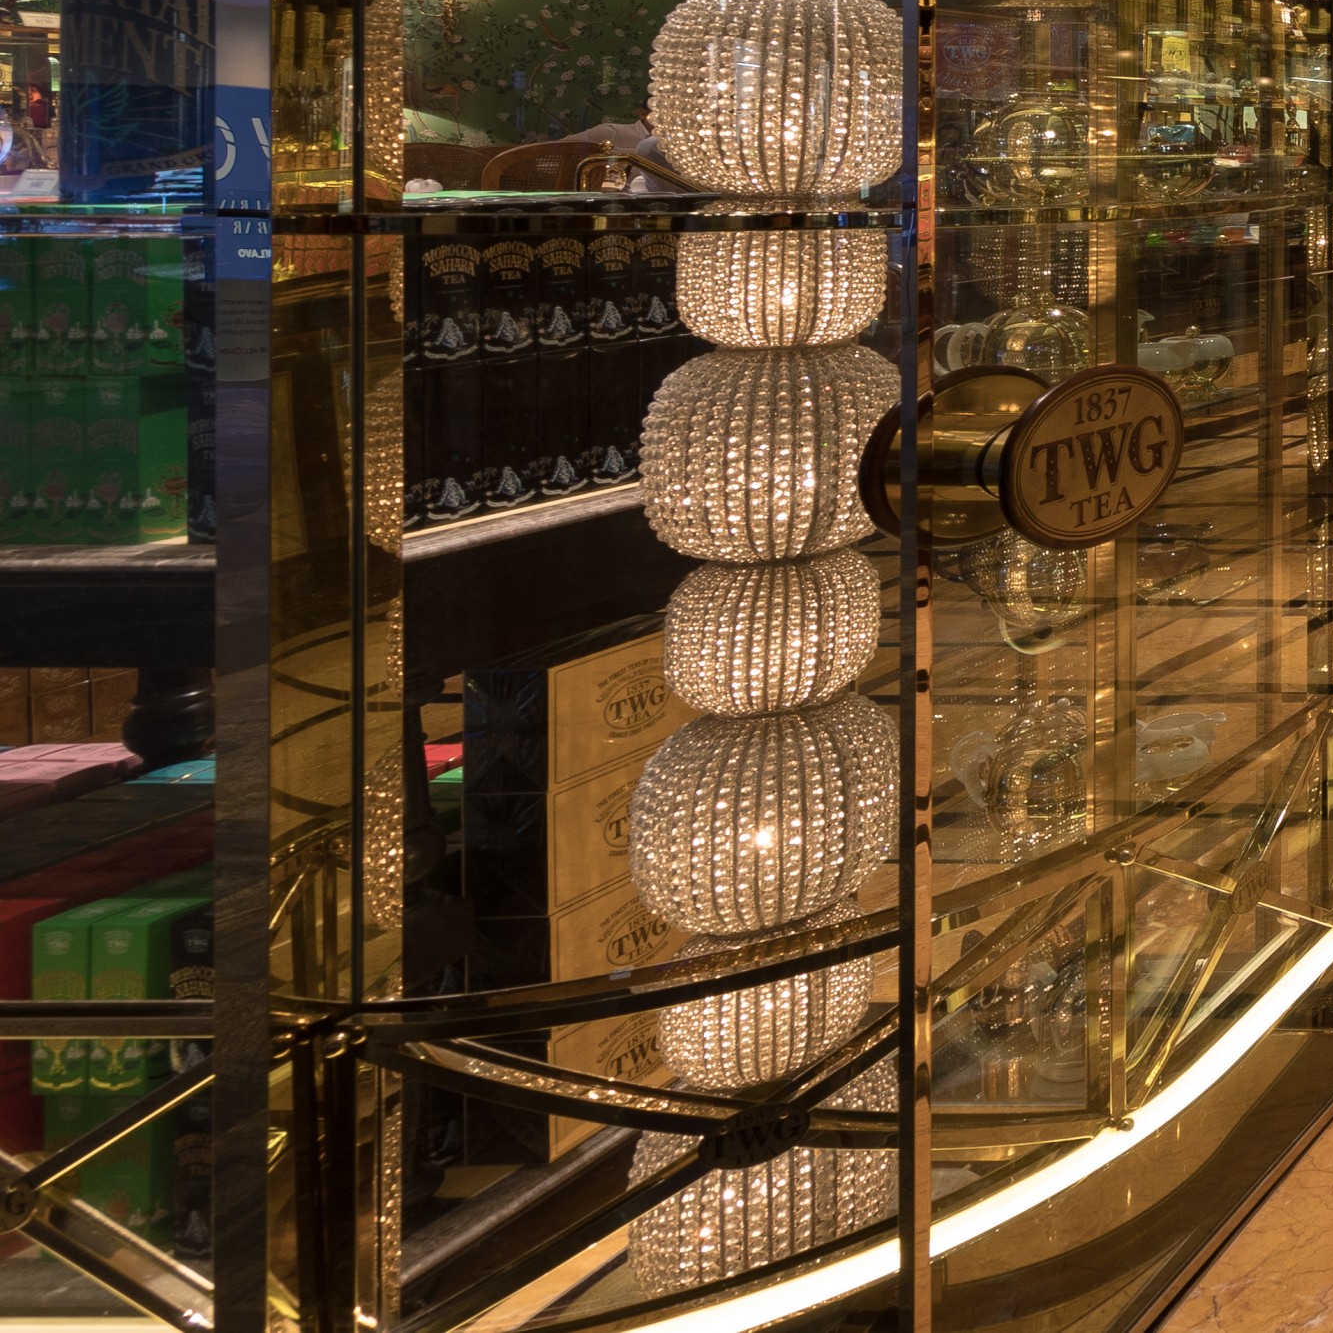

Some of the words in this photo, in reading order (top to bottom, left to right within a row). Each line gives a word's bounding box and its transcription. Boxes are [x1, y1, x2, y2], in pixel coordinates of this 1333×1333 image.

[945, 44, 989, 59] TWG
[423, 244, 482, 267] MOROCCAN
[483, 240, 536, 264] MOROCCAN
[542, 250, 581, 269] SAHARA
[430, 258, 476, 278] SAHARA
[489, 254, 530, 273] SAHARA
[553, 266, 572, 276] TEA
[442, 275, 465, 285] TEA
[501, 269, 521, 280] TEA
[1073, 386, 1132, 426] 1837
[1030, 414, 1169, 506] TWG
[1069, 494, 1136, 529] TEA
[626, 680, 650, 696] 1837
[609, 685, 666, 722] TWG
[624, 710, 651, 727] TEA
[611, 918, 668, 959] TWG
[626, 941, 654, 962] TEA
